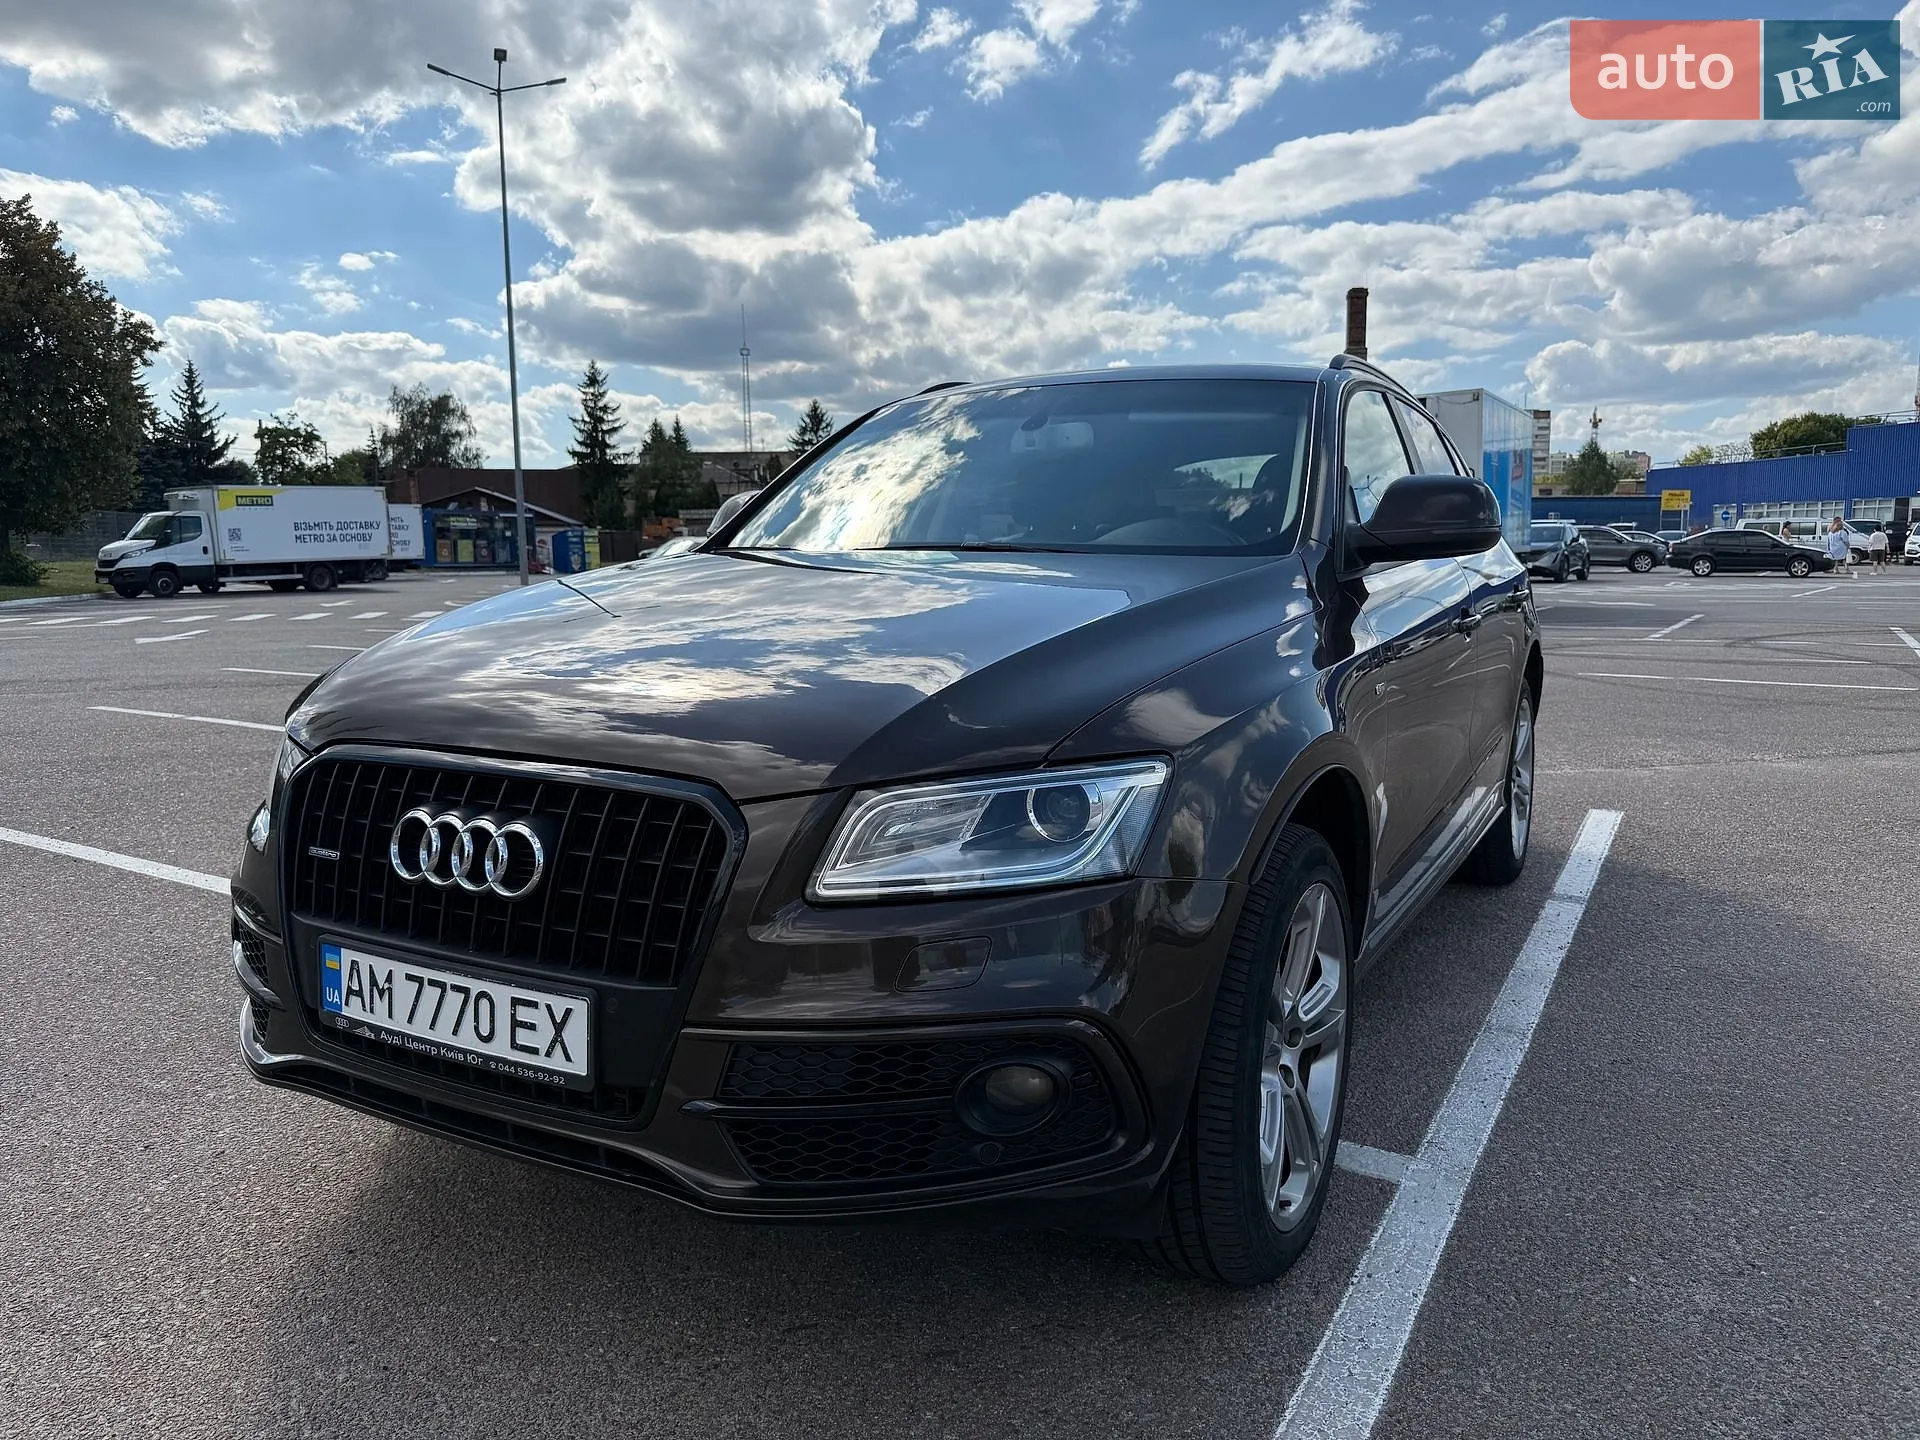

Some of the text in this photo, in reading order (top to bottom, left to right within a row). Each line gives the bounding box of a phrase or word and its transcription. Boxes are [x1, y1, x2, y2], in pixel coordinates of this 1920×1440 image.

[237, 496, 272, 505] METRO
[293, 520, 381, 532] ВІЗЬМІТЬ ДОСТАВКУ
[294, 532, 373, 543] METRO ЗА ОСНОВУ
[326, 986, 341, 1004] UA
[344, 959, 574, 1063] AM 7770 EX
[380, 1030, 566, 1085] Ауді Центр Київ Юг 044 536-92-92
